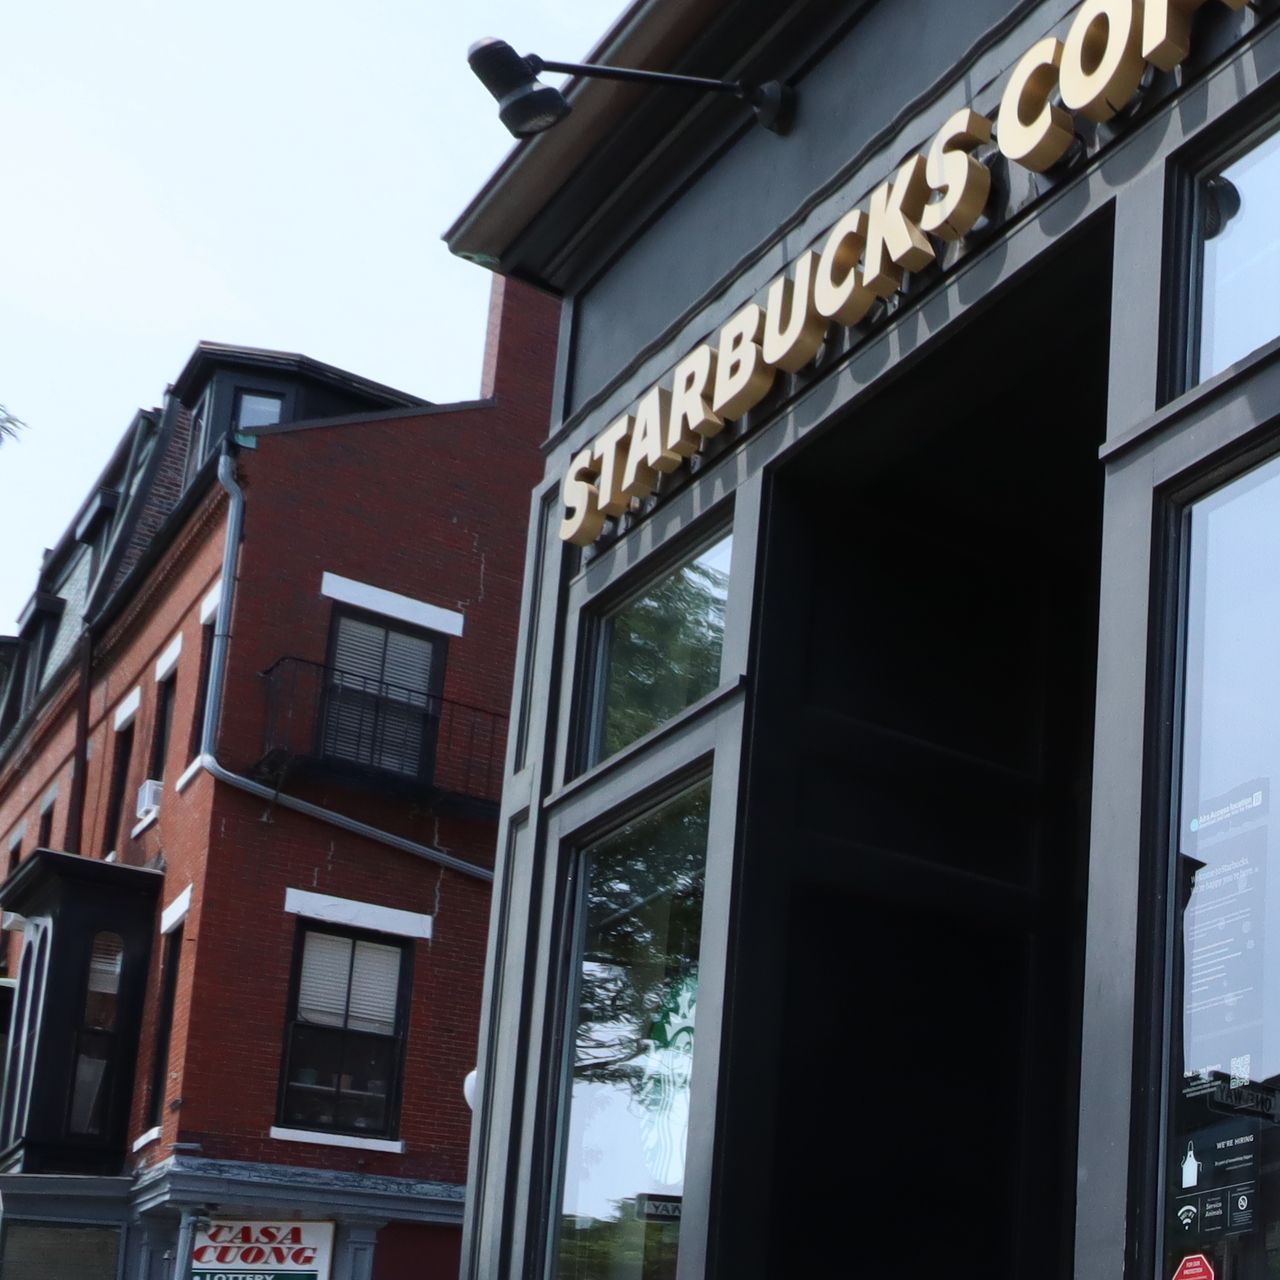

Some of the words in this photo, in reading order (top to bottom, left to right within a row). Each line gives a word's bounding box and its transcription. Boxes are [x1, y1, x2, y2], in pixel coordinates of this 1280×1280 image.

[560, 108, 991, 545] STARBUCKS
[208, 1224, 303, 1245] CASA
[192, 1245, 318, 1265] CUONG
